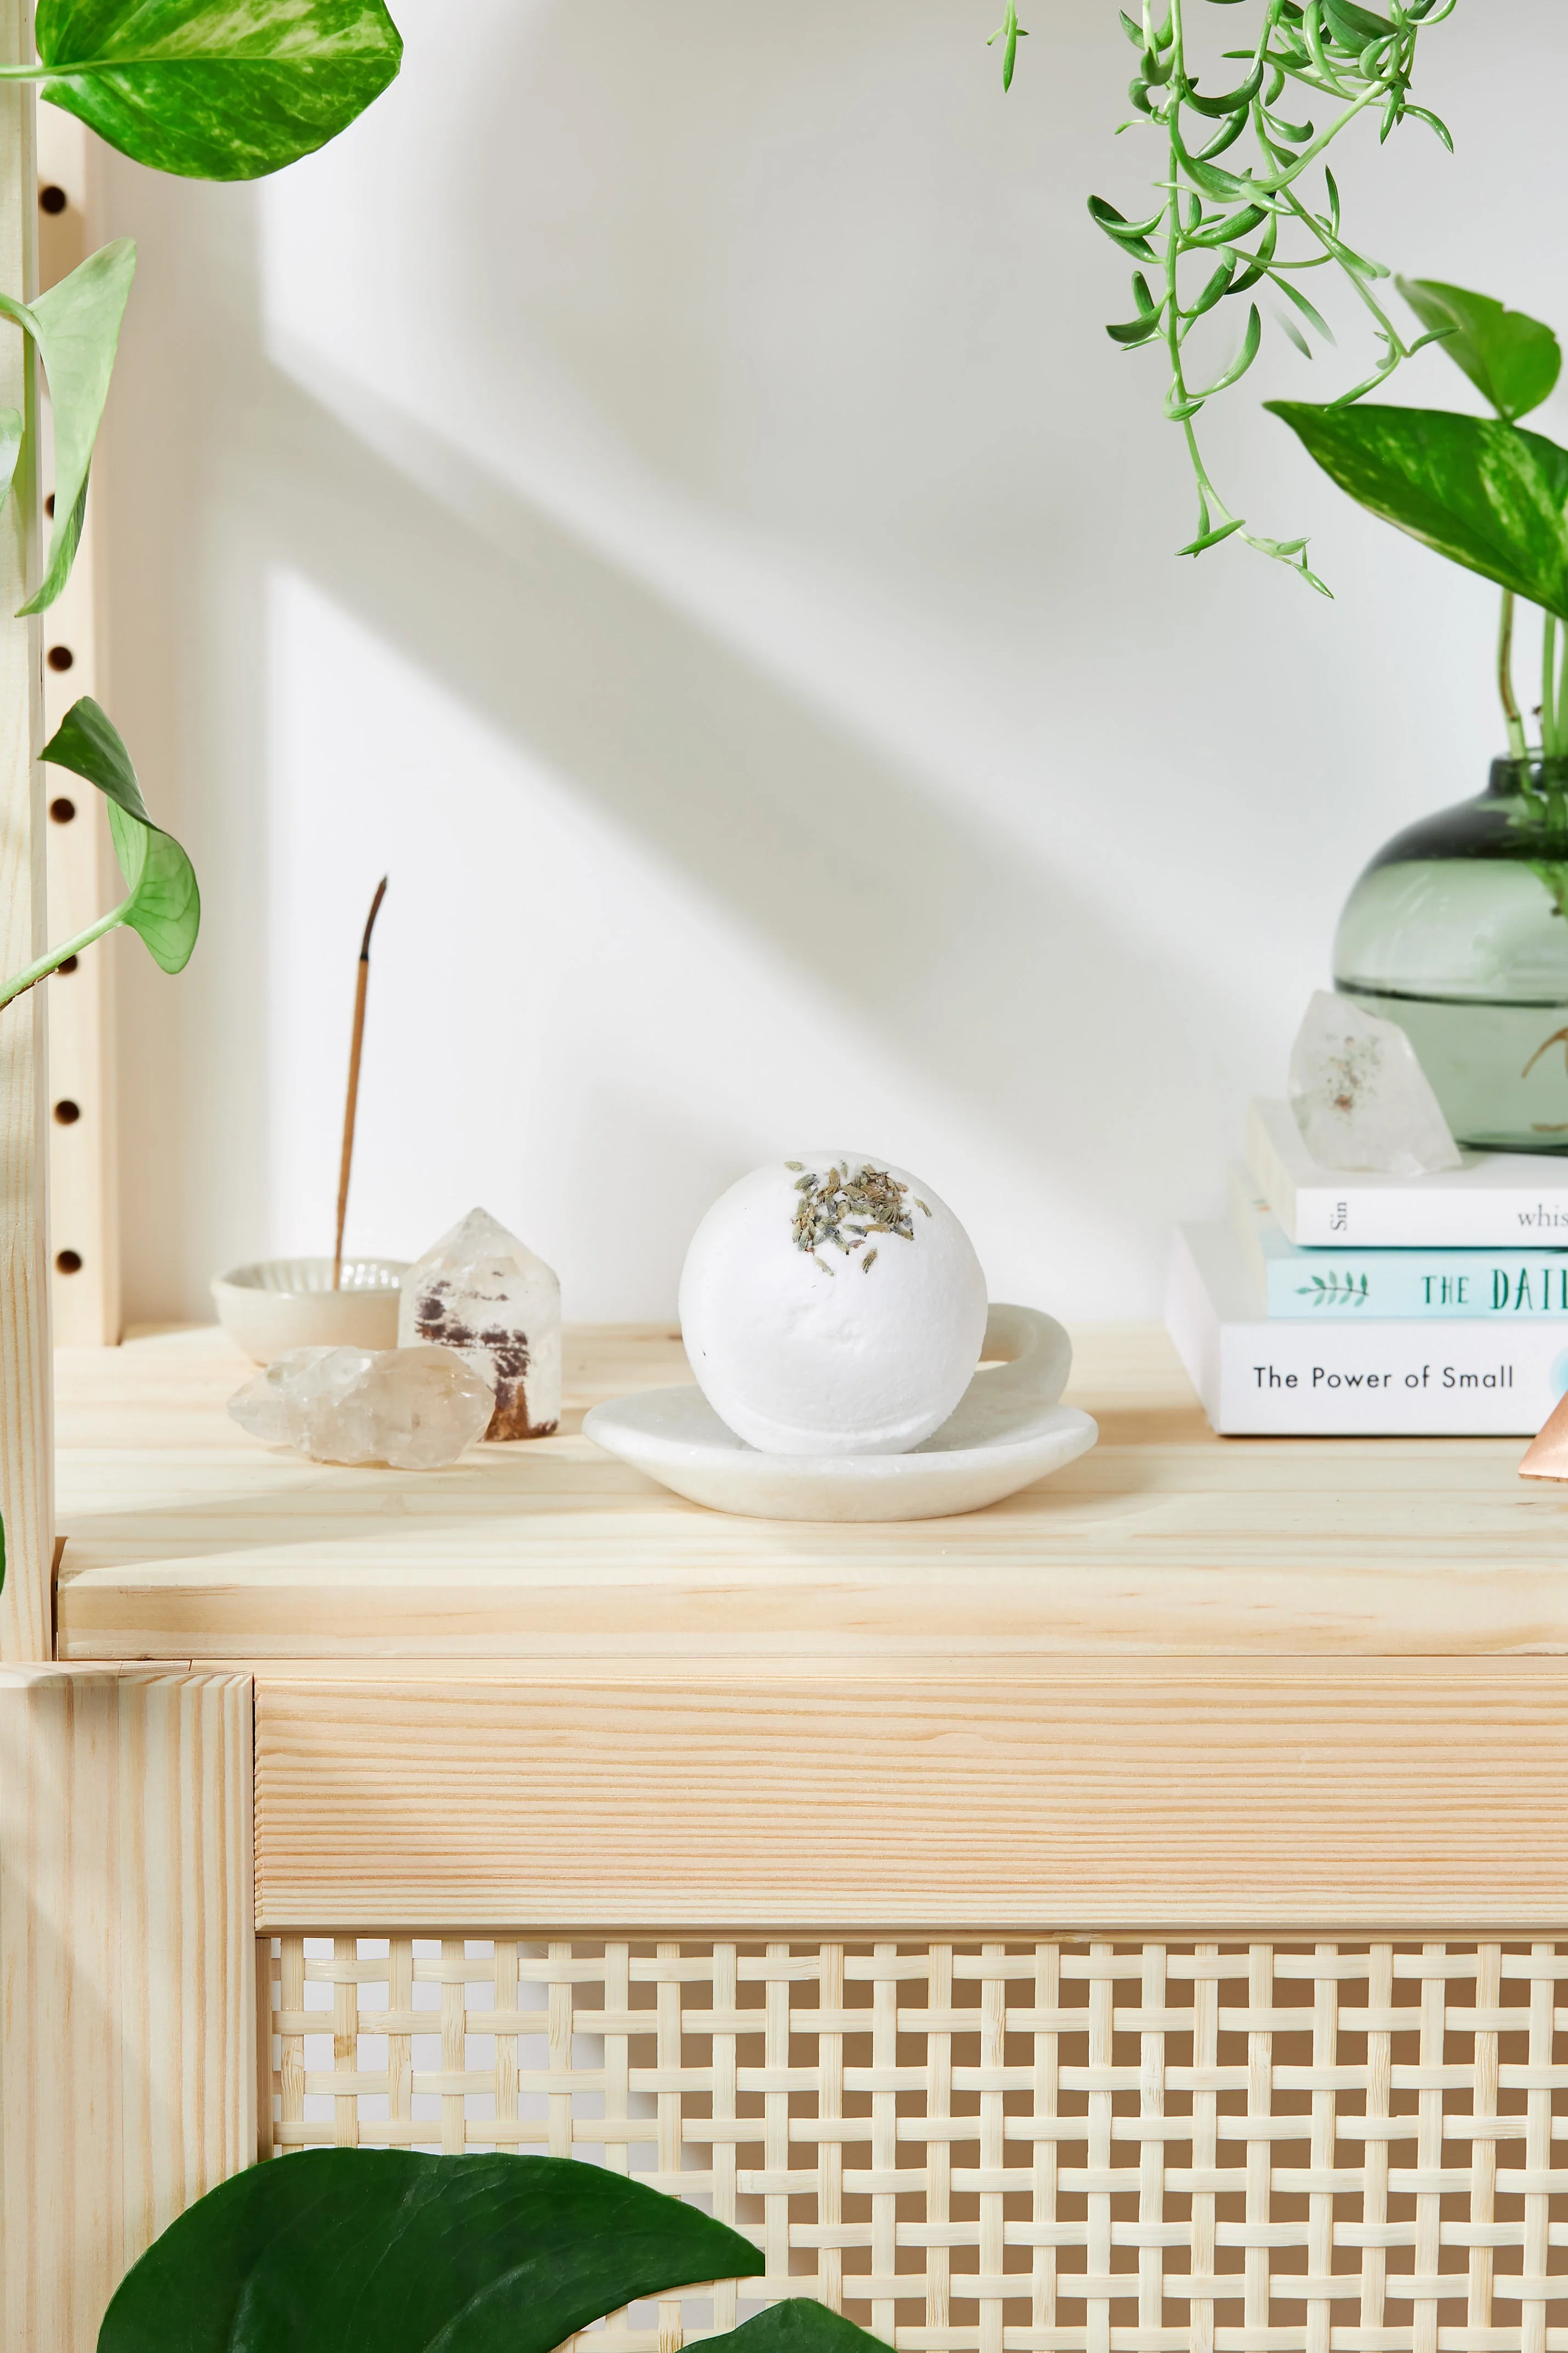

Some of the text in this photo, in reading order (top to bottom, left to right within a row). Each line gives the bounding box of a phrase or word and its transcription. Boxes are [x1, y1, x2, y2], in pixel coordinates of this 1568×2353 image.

[1330, 1201, 1347, 1231] Sin
[1421, 1275, 1469, 1305] THE
[1253, 1364, 1514, 1389] The Power of Small
